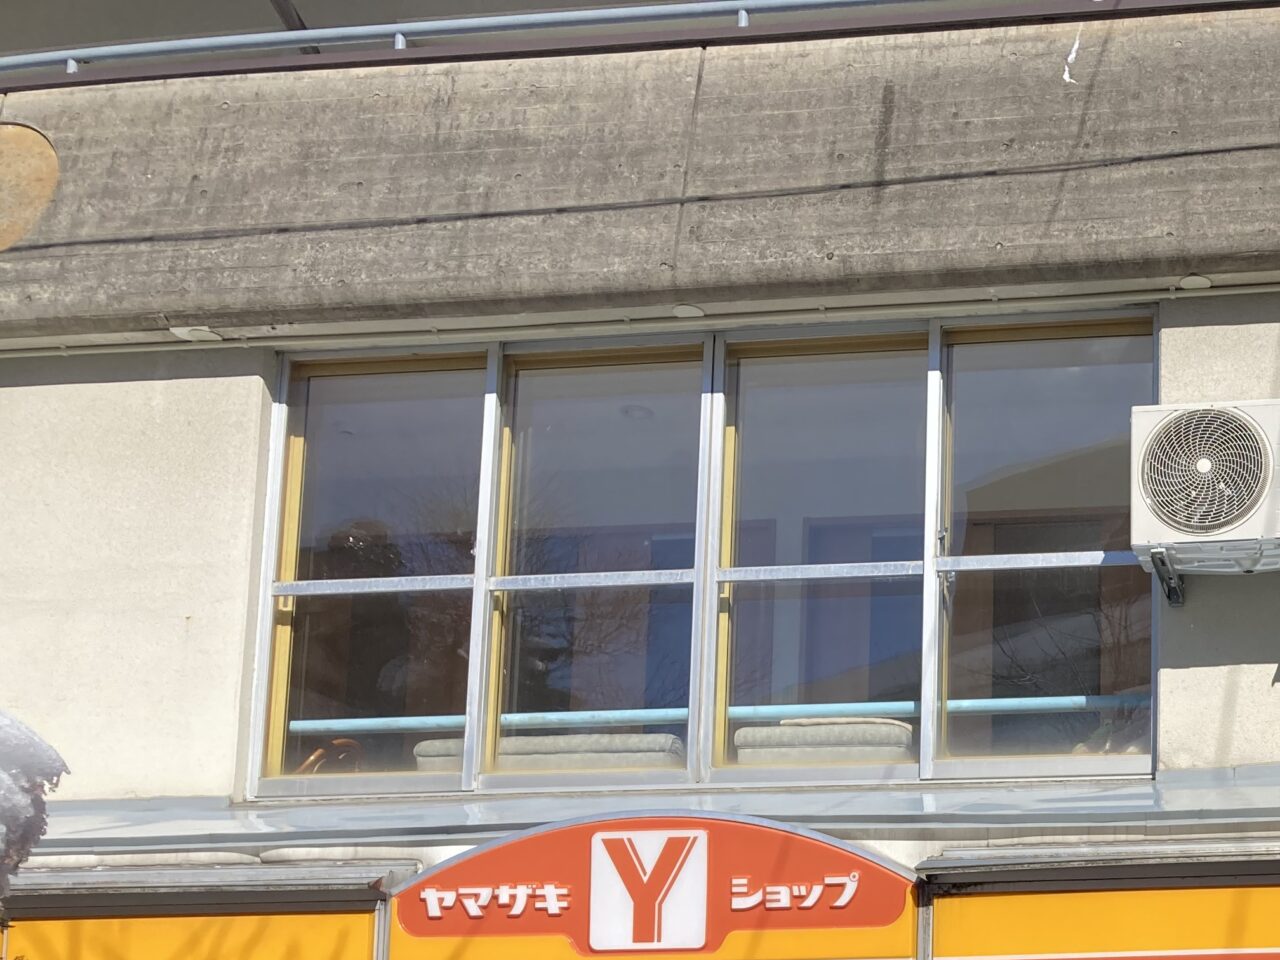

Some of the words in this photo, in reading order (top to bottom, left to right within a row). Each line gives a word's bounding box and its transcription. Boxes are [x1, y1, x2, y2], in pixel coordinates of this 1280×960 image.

[419, 882, 572, 919] ヤマザキ
[601, 836, 699, 944] Y
[731, 871, 861, 911] ショップ
